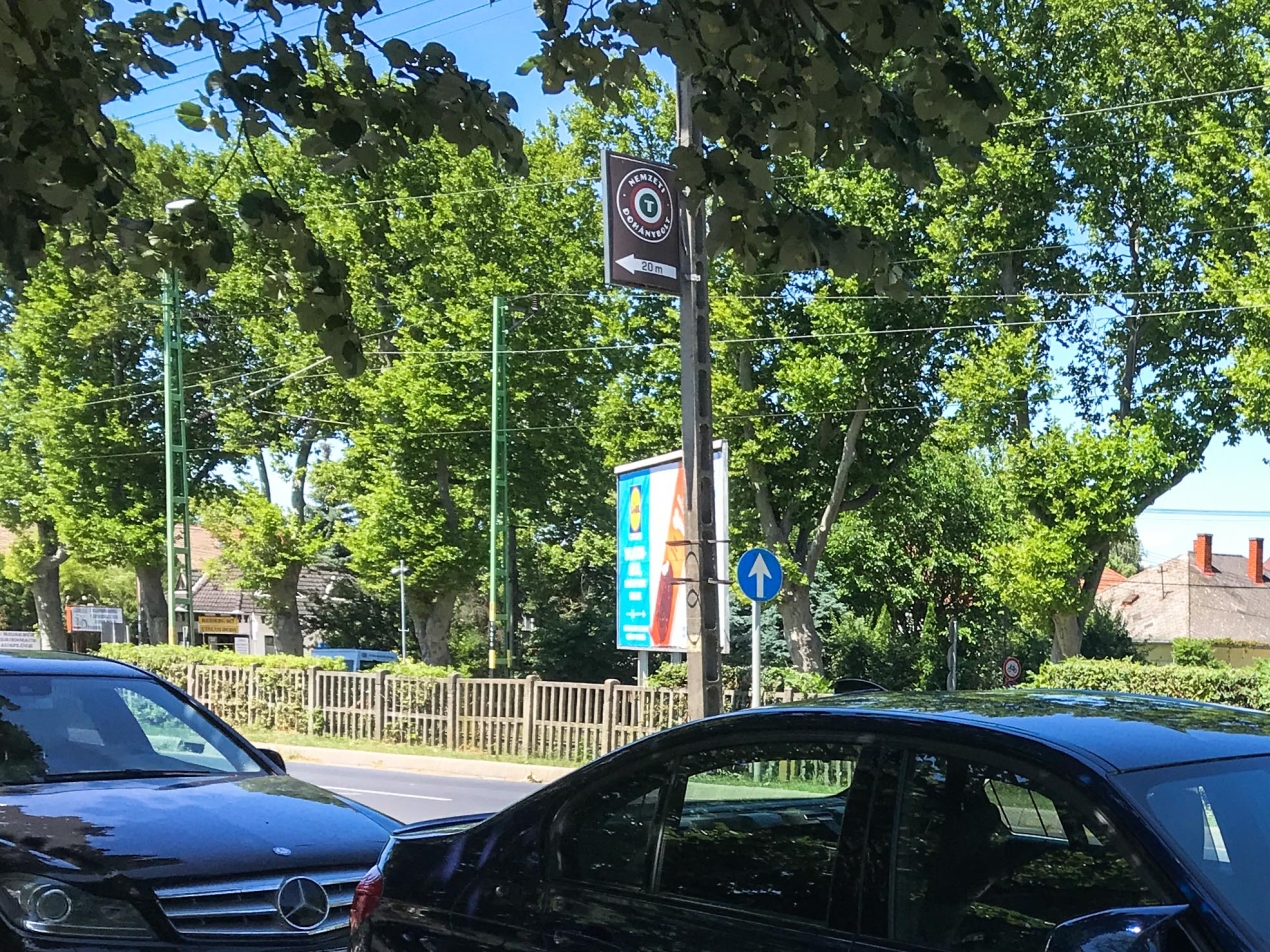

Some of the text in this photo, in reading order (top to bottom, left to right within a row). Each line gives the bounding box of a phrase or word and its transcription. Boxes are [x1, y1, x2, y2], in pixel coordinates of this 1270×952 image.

[628, 173, 666, 194] NEMZETI
[643, 199, 655, 213] T
[622, 207, 671, 238] DOHÁNYBOLT
[641, 261, 663, 275] 20 m
